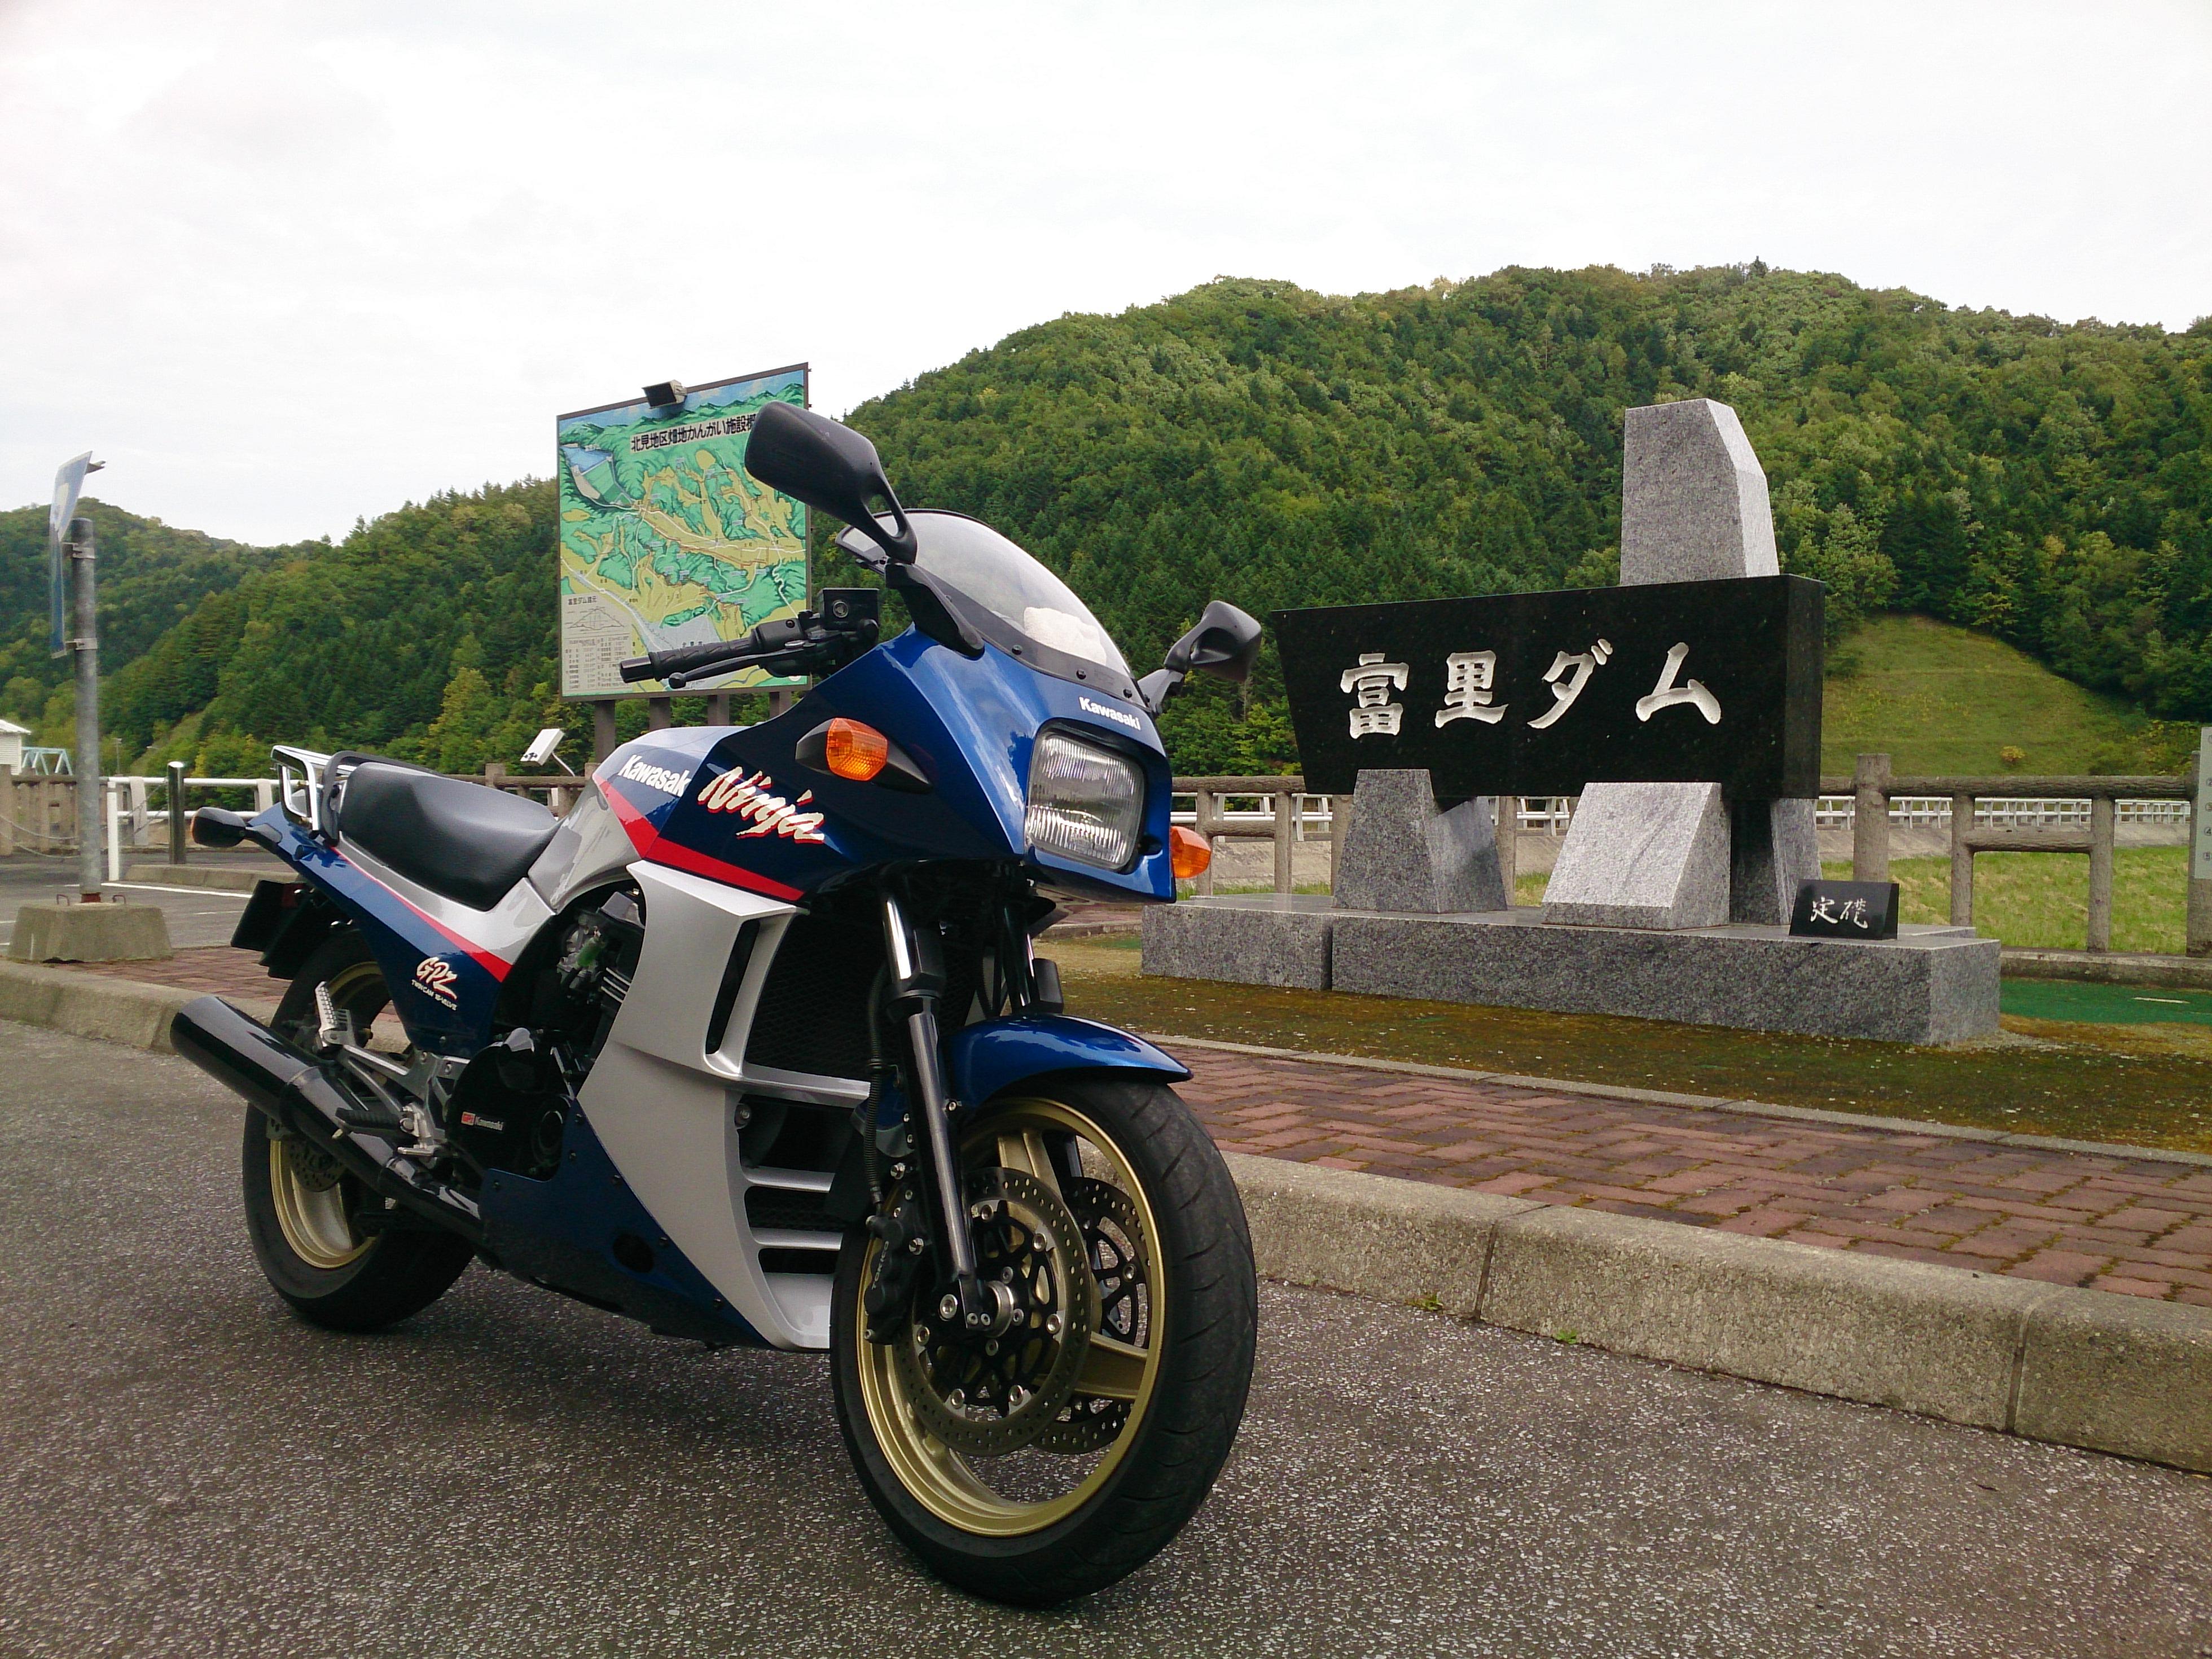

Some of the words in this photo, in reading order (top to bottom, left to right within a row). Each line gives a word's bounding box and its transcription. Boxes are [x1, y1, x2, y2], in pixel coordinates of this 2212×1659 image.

[1079, 696, 1141, 731] Kawasaki
[1341, 639, 1721, 740] 富里ダム
[618, 754, 692, 797] Kawasak
[697, 766, 825, 844] Ninja
